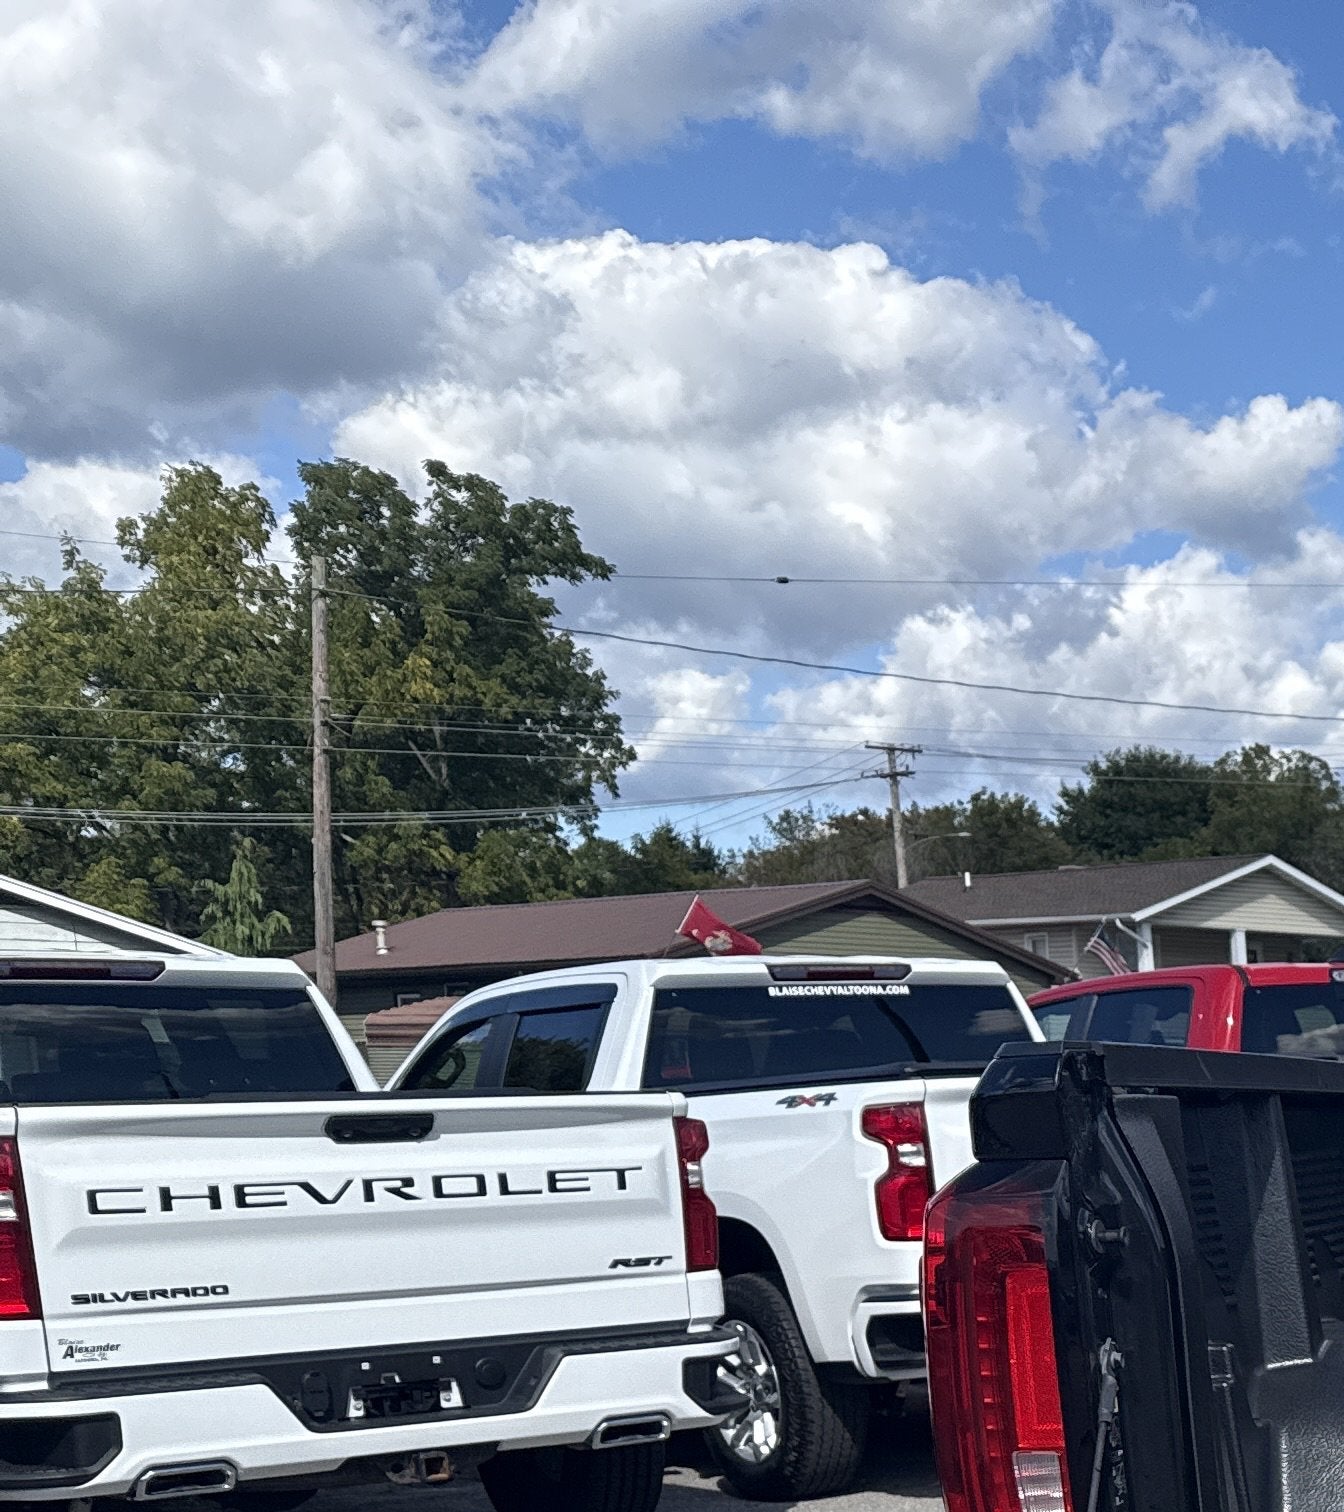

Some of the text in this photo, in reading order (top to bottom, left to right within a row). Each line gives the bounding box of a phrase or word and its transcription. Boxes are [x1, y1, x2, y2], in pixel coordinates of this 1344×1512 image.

[768, 985, 910, 996] BLAISECHEVYALTOONA.COM
[86, 1165, 643, 1216] CHEVROLET
[608, 1256, 673, 1269] RST
[71, 1284, 229, 1305] SILVERADO
[62, 1342, 121, 1359] Alexander
